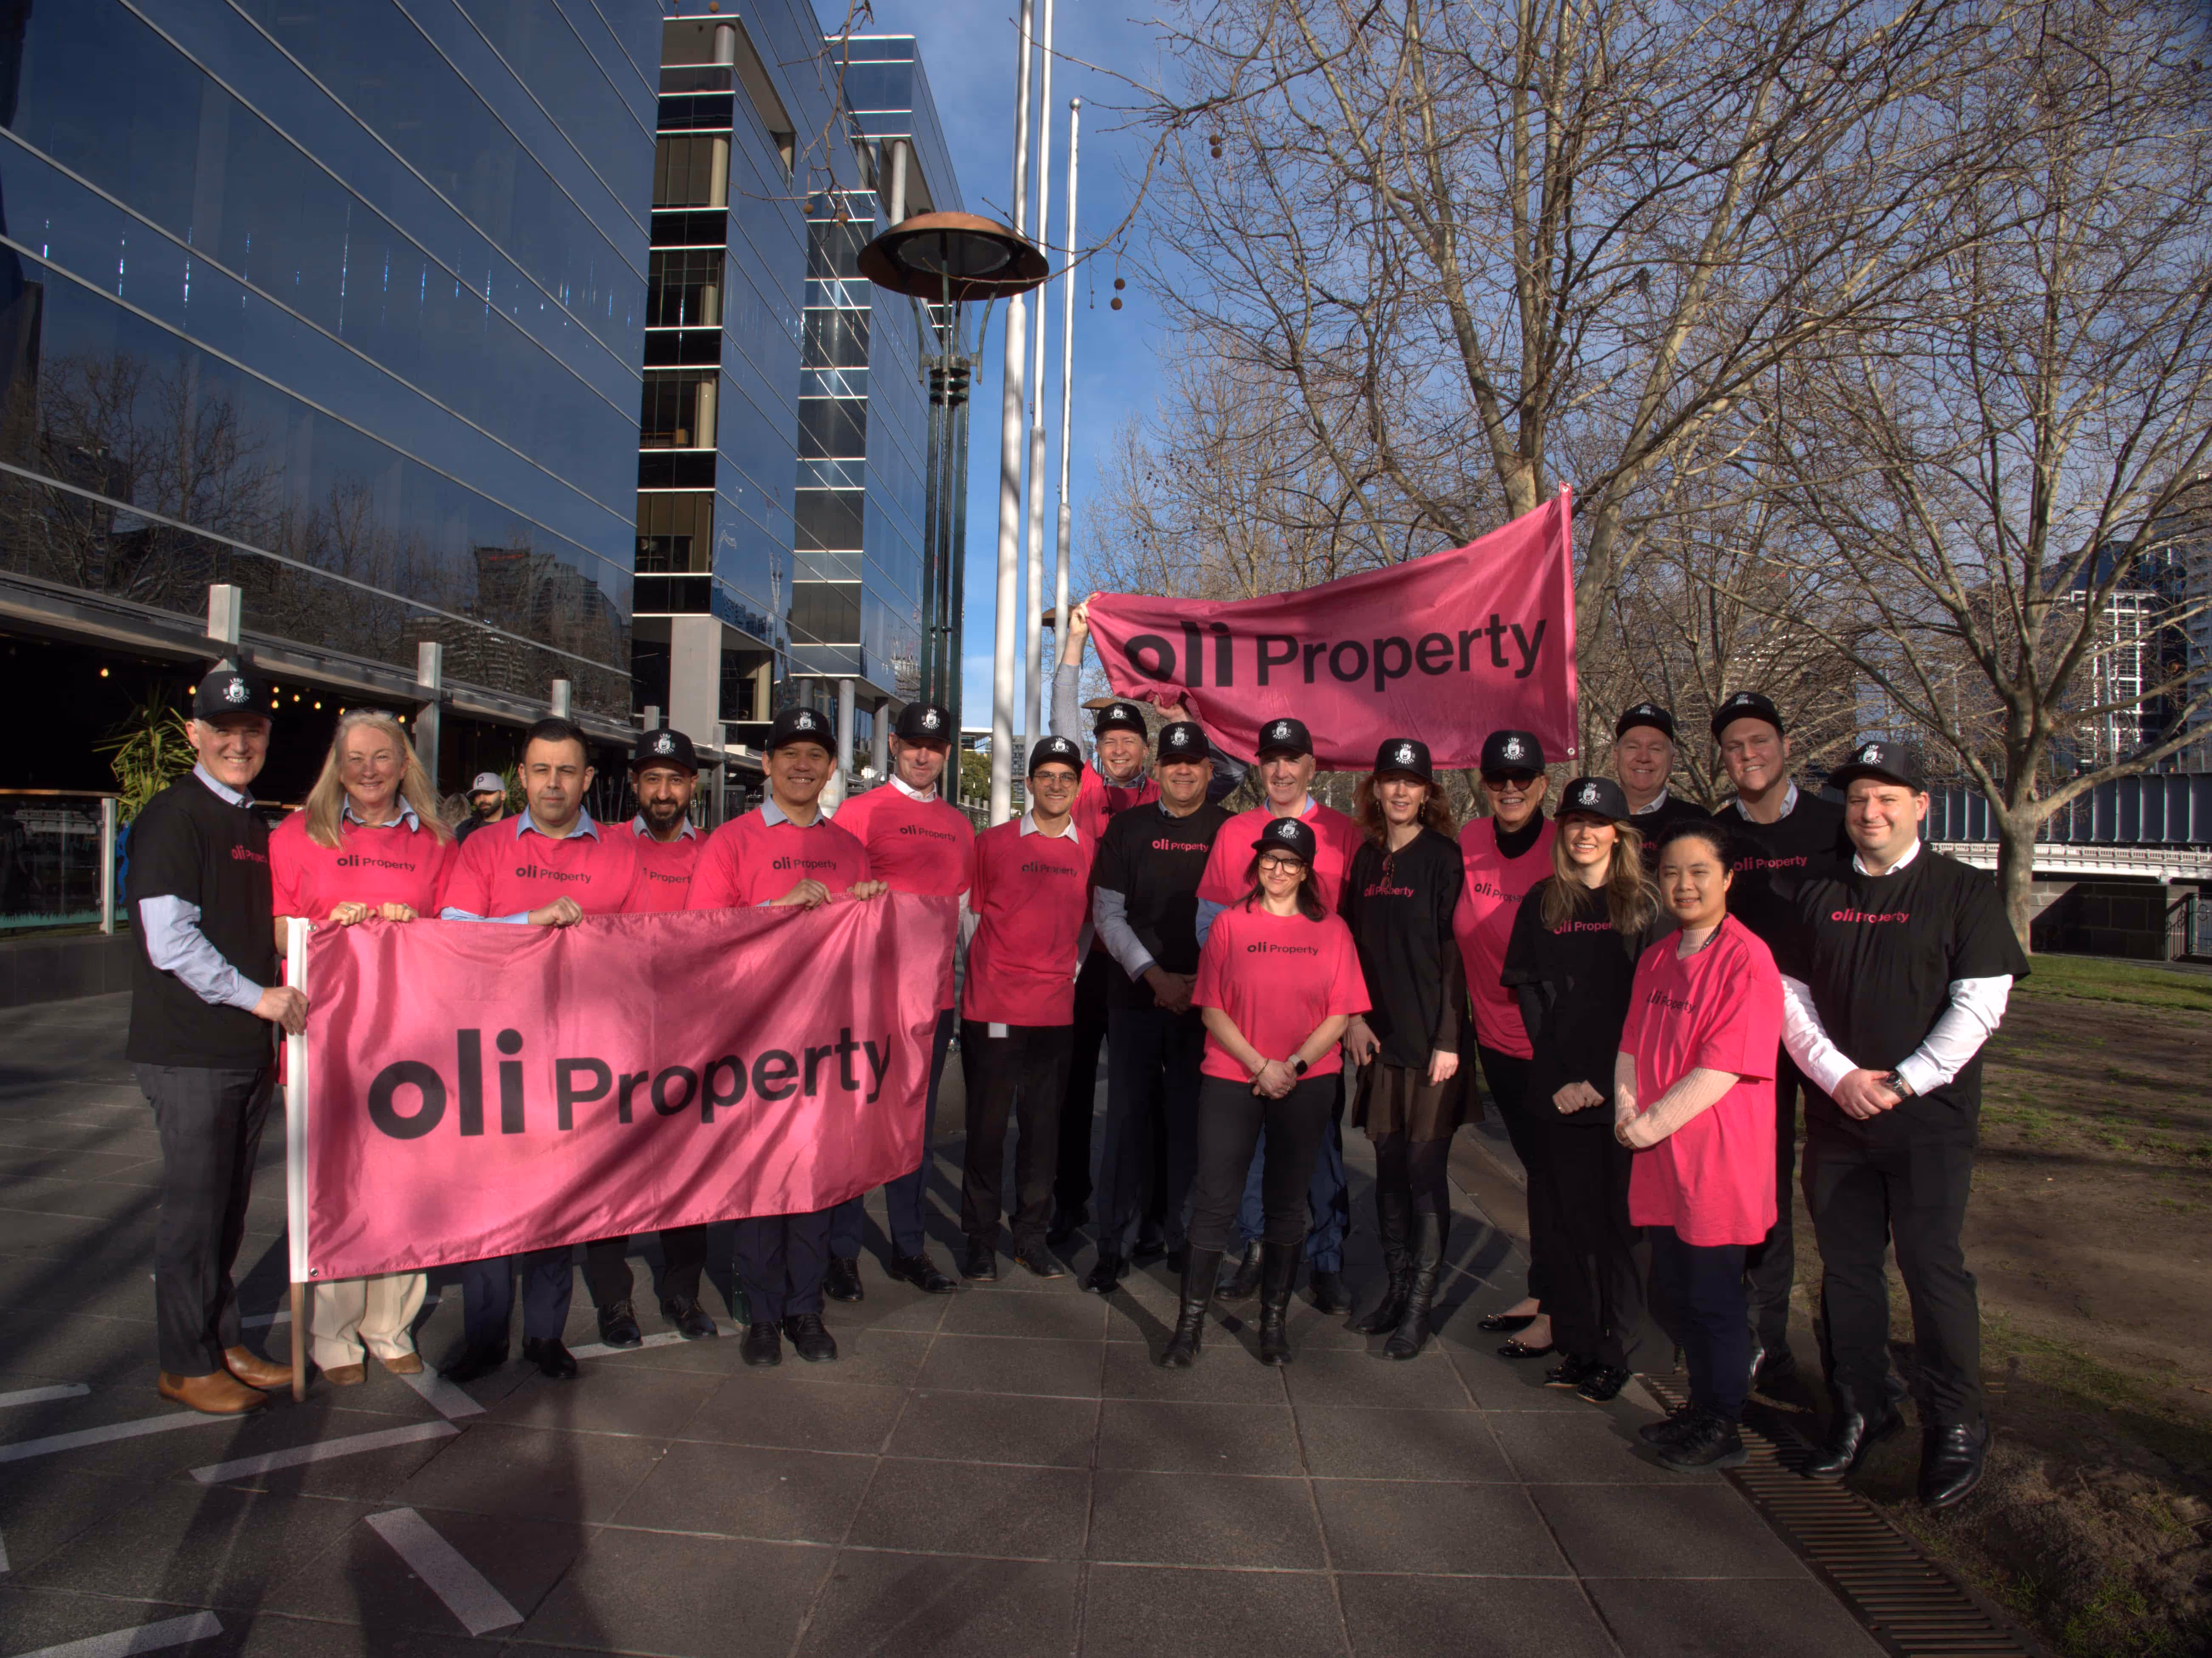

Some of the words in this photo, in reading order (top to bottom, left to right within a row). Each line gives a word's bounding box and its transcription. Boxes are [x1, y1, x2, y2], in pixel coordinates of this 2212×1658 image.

[1124, 621, 1233, 688] oli
[1256, 613, 1546, 693] Property
[477, 776, 485, 786] P
[899, 825, 916, 835] oli
[918, 828, 956, 842] Property
[231, 845, 245, 860] oli
[1152, 839, 1169, 850] oli
[1171, 843, 1208, 852] Property
[337, 854, 359, 867] oli
[363, 858, 415, 871] Property
[773, 856, 791, 870] oli
[793, 859, 837, 870] Property
[1021, 861, 1038, 872] oli
[1041, 864, 1078, 877] Property
[1733, 857, 1754, 871] oli
[1756, 856, 1808, 869] Property
[516, 865, 537, 878] oli
[540, 869, 591, 884] Property
[650, 871, 691, 884] Propert
[1364, 883, 1376, 897] oli
[1475, 883, 1492, 896] oli
[1493, 890, 1522, 903] Prope
[1831, 908, 1855, 922] oli
[1553, 919, 1572, 935] oli
[1574, 921, 1611, 932] Proper
[1247, 942, 1267, 952] oli
[1270, 945, 1318, 956] Property
[1662, 995, 1696, 1014] Poperty
[367, 1028, 525, 1140] oli
[556, 1027, 892, 1131] Property
